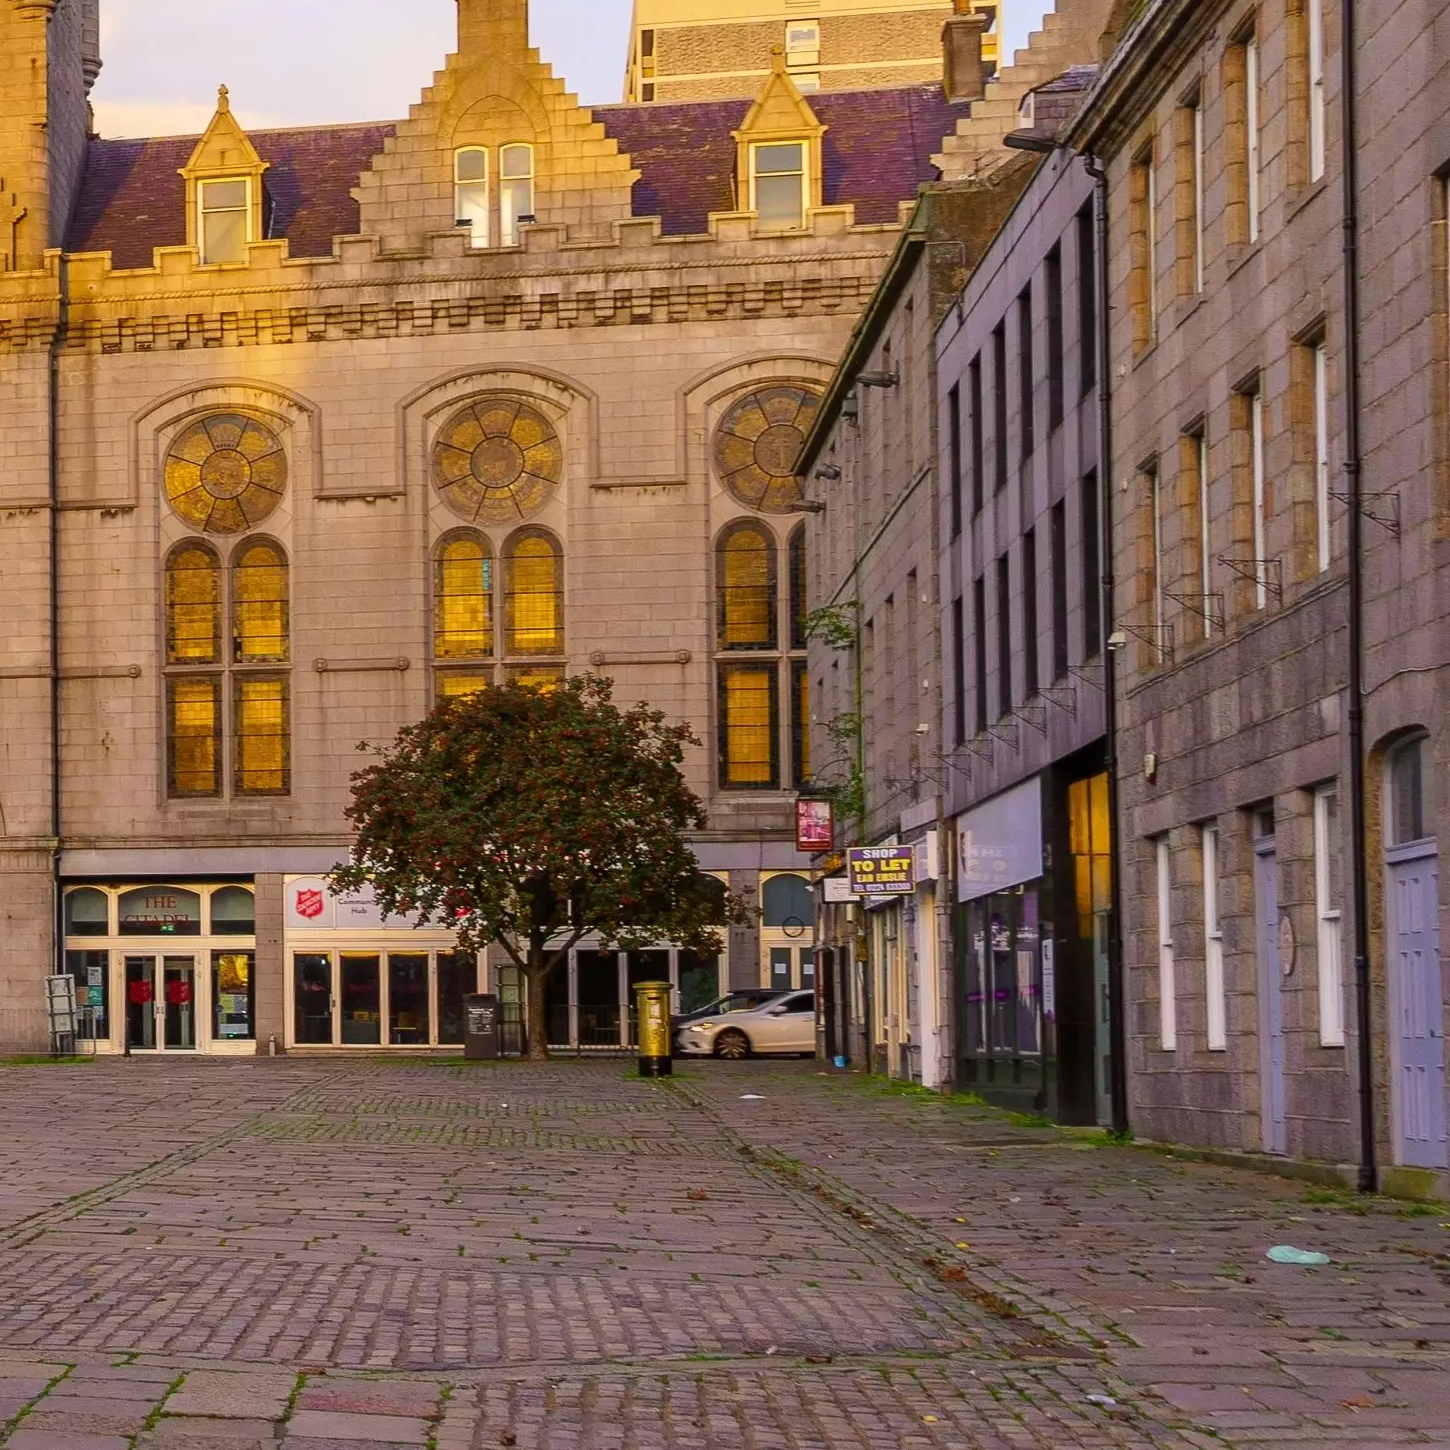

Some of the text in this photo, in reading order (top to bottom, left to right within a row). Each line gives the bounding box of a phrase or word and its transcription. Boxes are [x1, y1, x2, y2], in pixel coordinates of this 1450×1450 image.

[862, 849, 898, 859] SHOP
[852, 859, 911, 872] TO LET
[144, 895, 177, 908] THE
[351, 906, 367, 914] Hub
